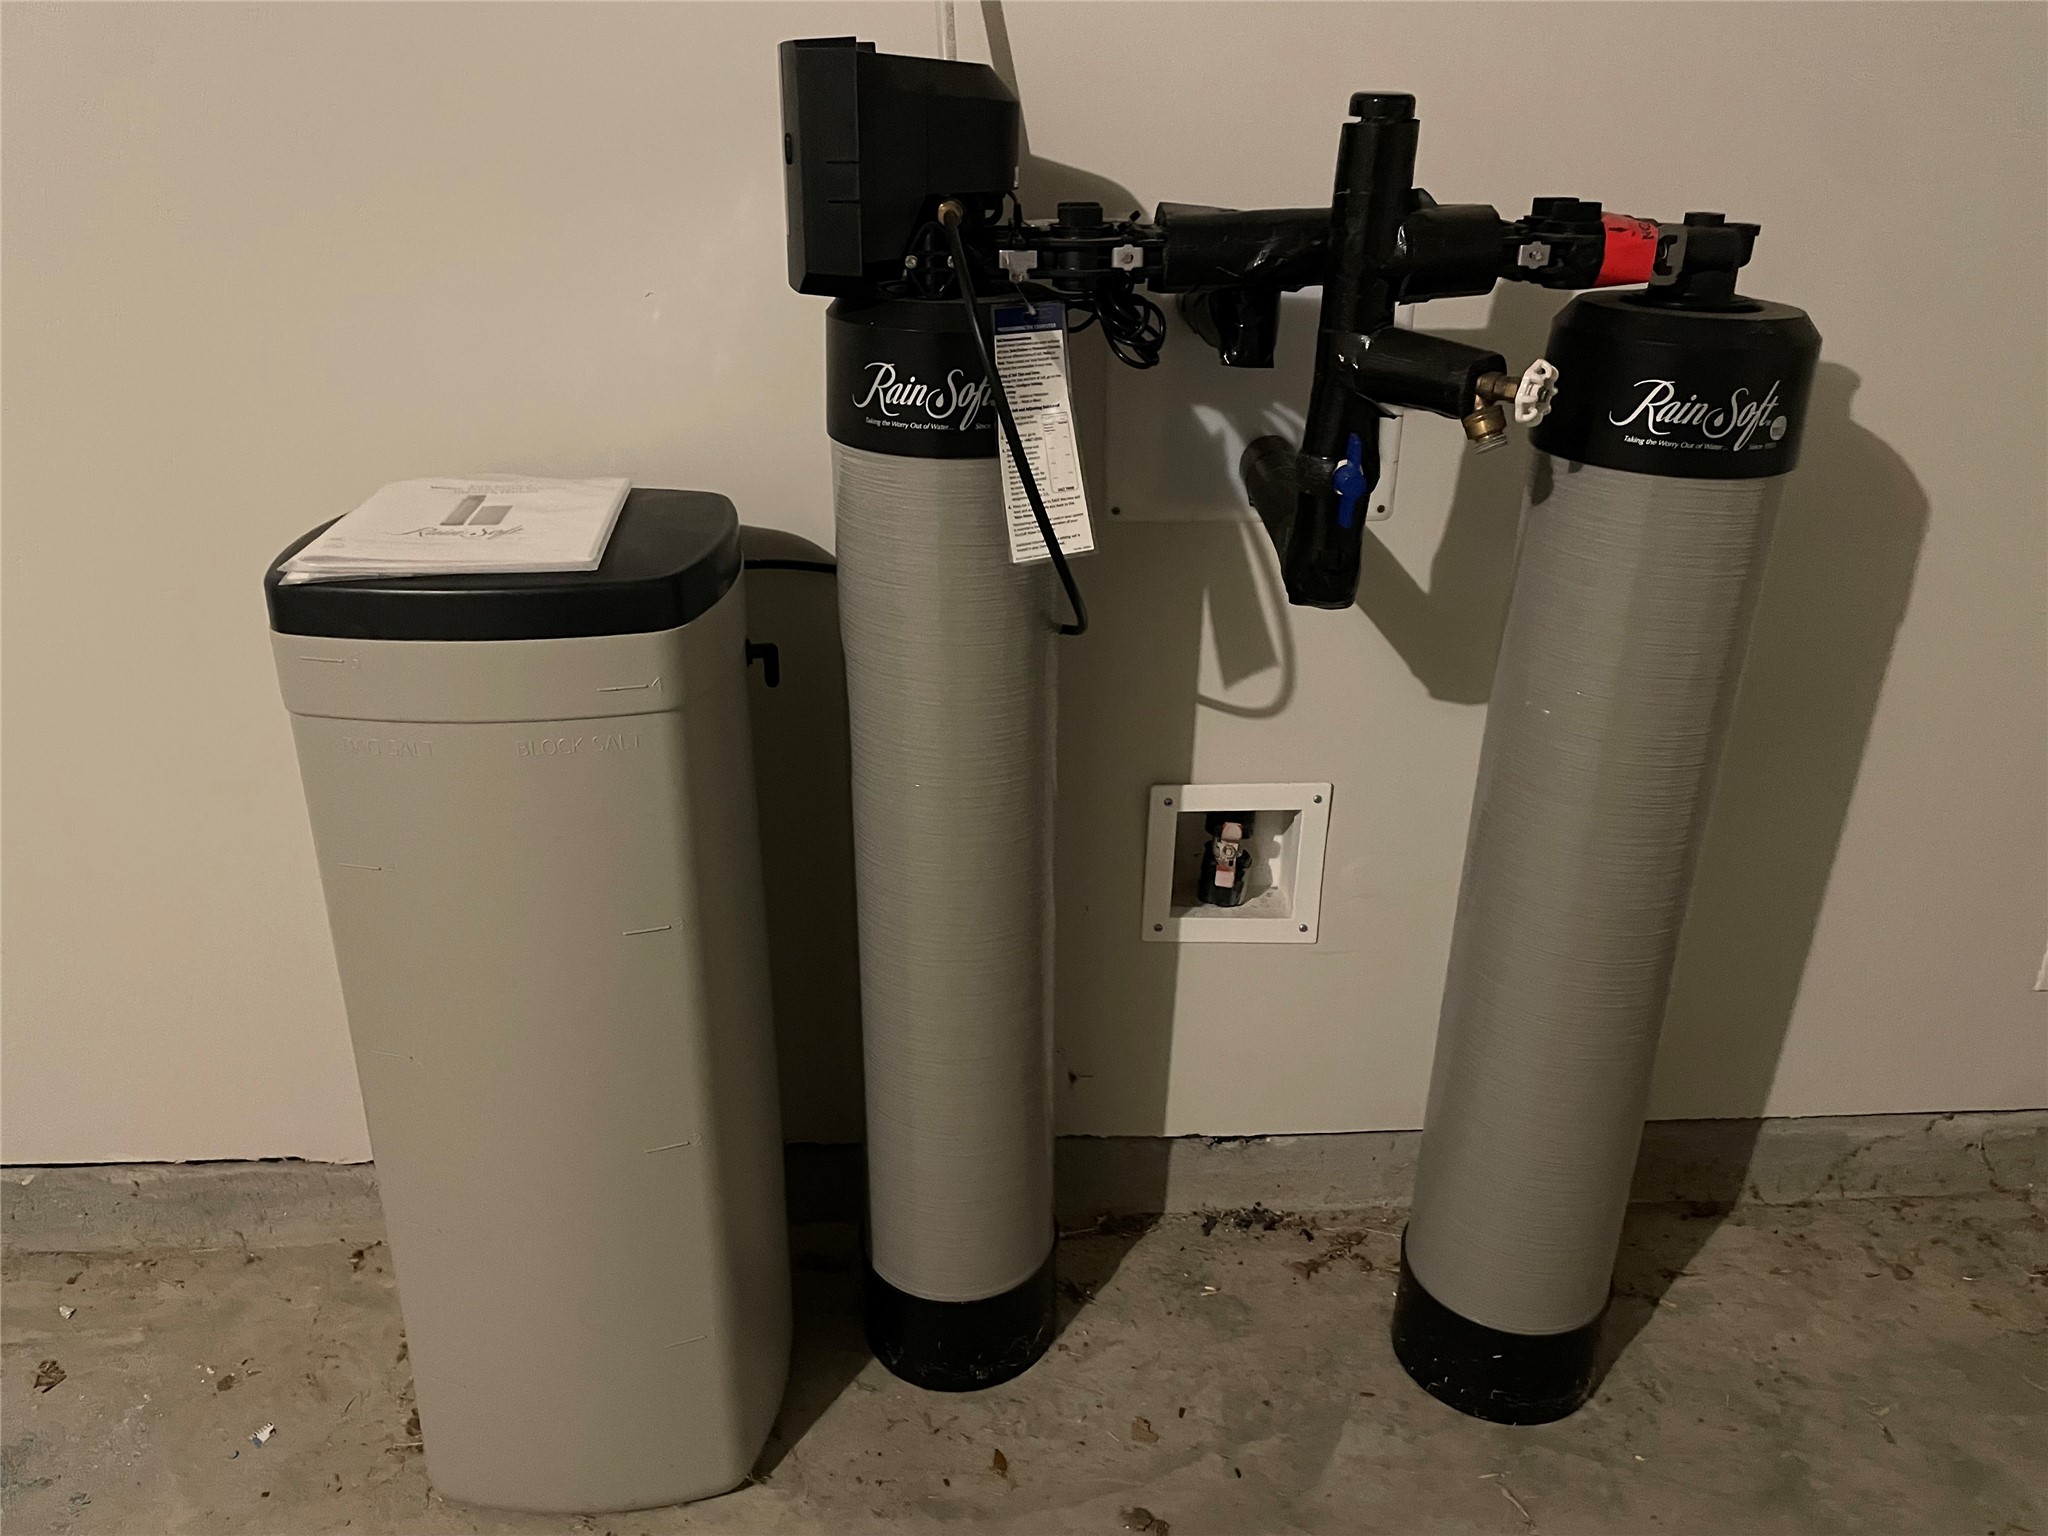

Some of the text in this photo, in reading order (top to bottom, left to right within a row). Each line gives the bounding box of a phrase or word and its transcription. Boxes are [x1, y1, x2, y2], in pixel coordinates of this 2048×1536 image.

[865, 417, 881, 427] Taking
[881, 418, 891, 427] the
[891, 420, 909, 429] Worry
[910, 422, 923, 430] Out
[923, 422, 931, 430] of
[1623, 435, 1645, 446] Taking
[1645, 438, 1657, 446] the
[1658, 440, 1680, 449] Worry
[1695, 442, 1704, 450] of
[517, 733, 643, 757] BLOCK SALT
